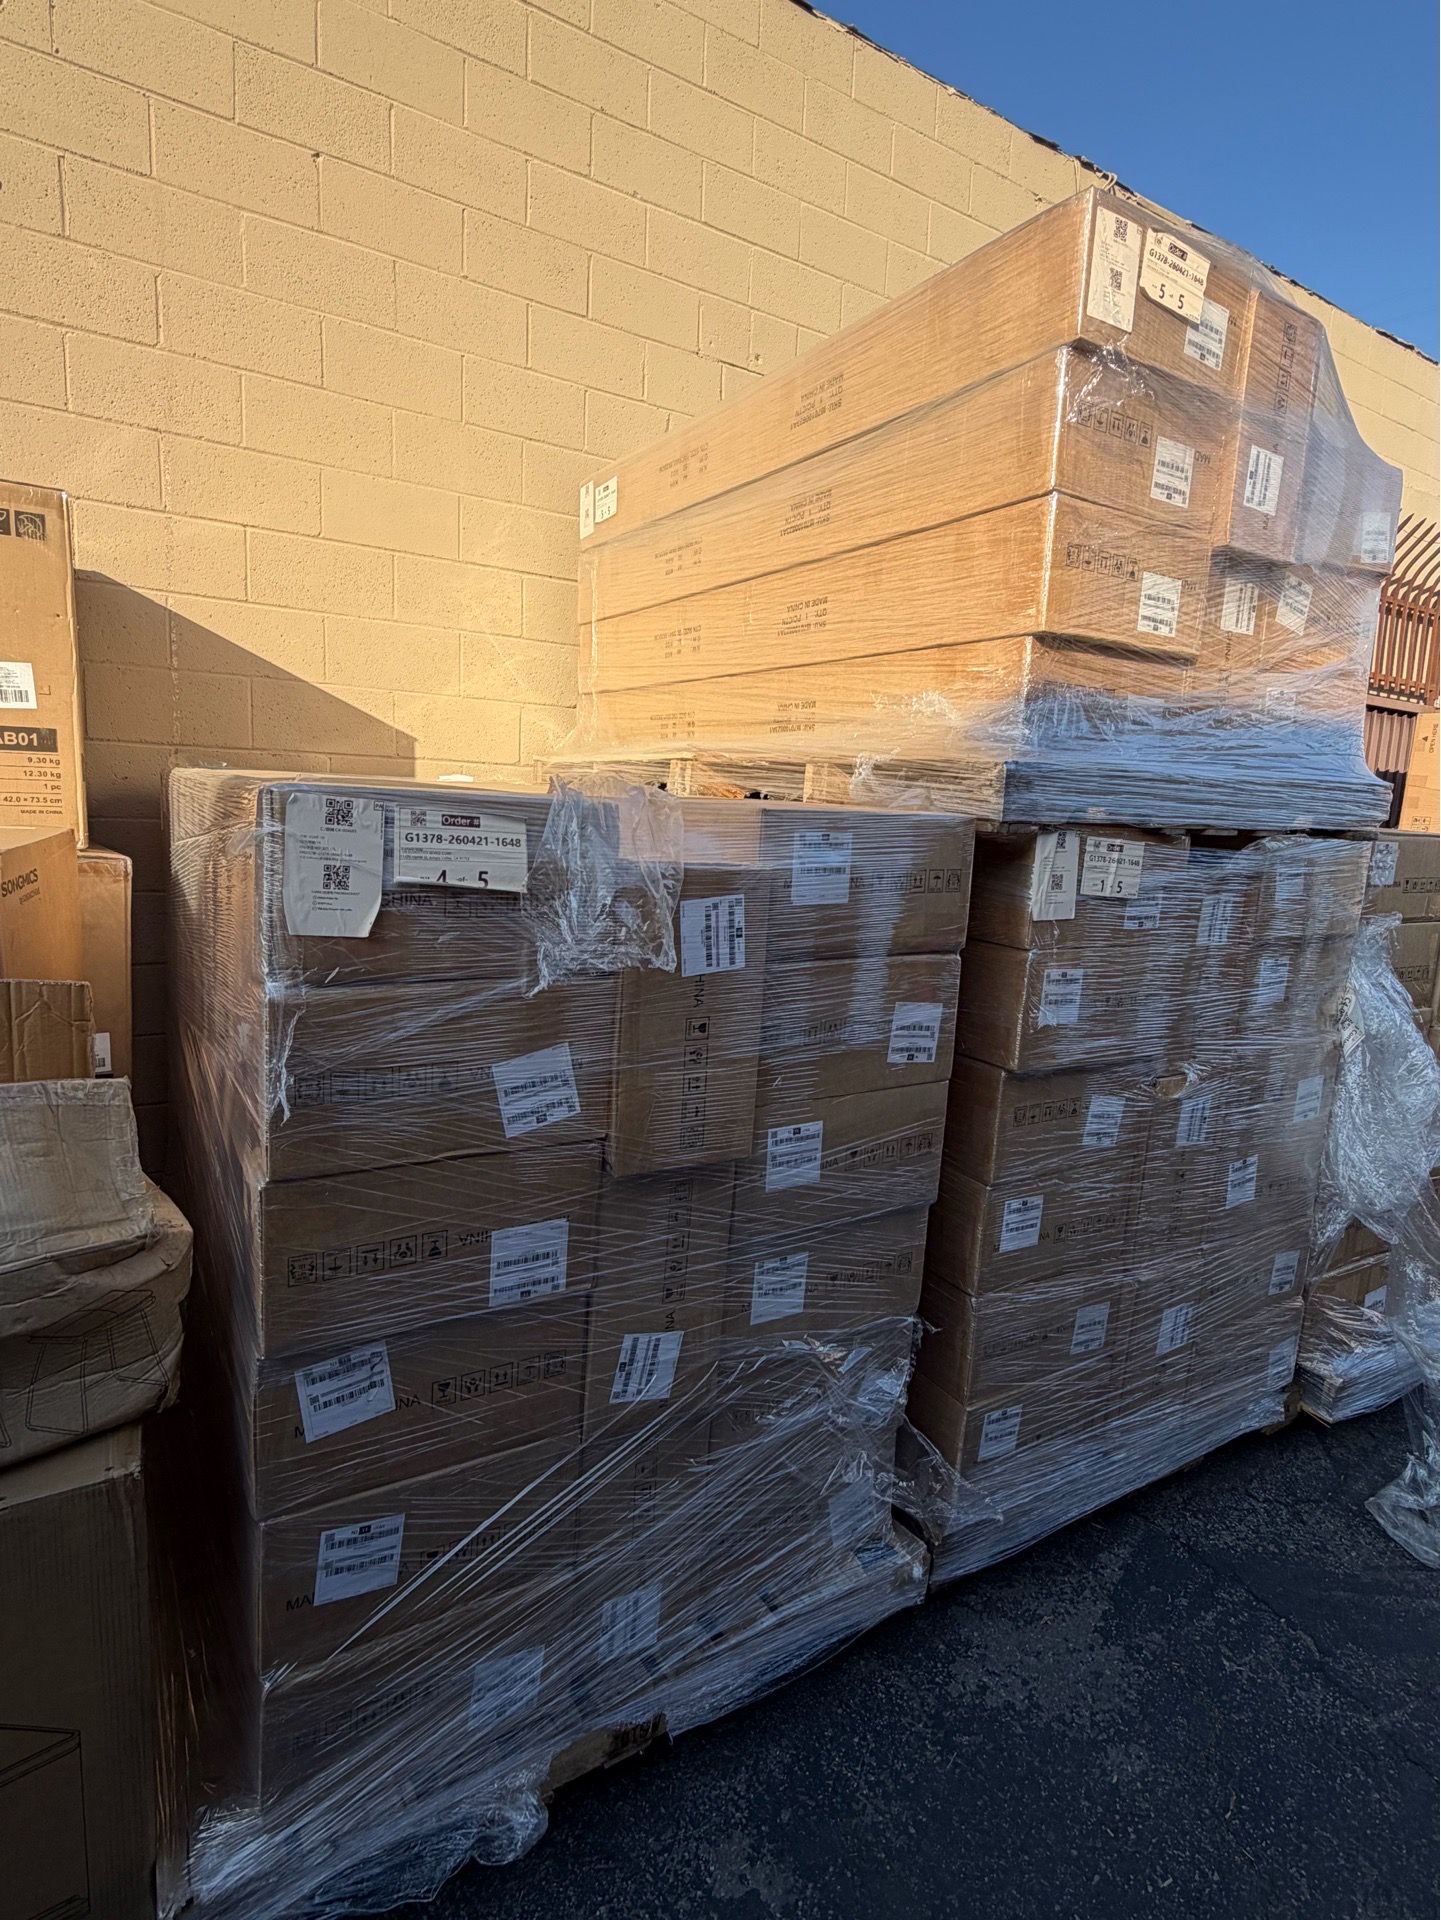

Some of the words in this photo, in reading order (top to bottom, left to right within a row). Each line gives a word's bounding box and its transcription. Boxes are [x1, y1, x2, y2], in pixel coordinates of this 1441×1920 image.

[1158, 283, 1166, 299] 5
[1177, 294, 1185, 310] 5
[27, 756, 47, 764] 9.30
[49, 757, 61, 766] kg
[23, 770, 48, 778] 12.30
[50, 770, 61, 779] kg
[3, 795, 21, 803] 42.0
[441, 815, 472, 827] Order
[472, 818, 481, 826] #
[405, 832, 522, 848] G1378-260421-1648
[478, 870, 489, 888] 5
[1100, 879, 1105, 892] 1
[1116, 880, 1123, 894] 5
[693, 974, 707, 1008] HINA
[395, 1394, 421, 1412] INA
